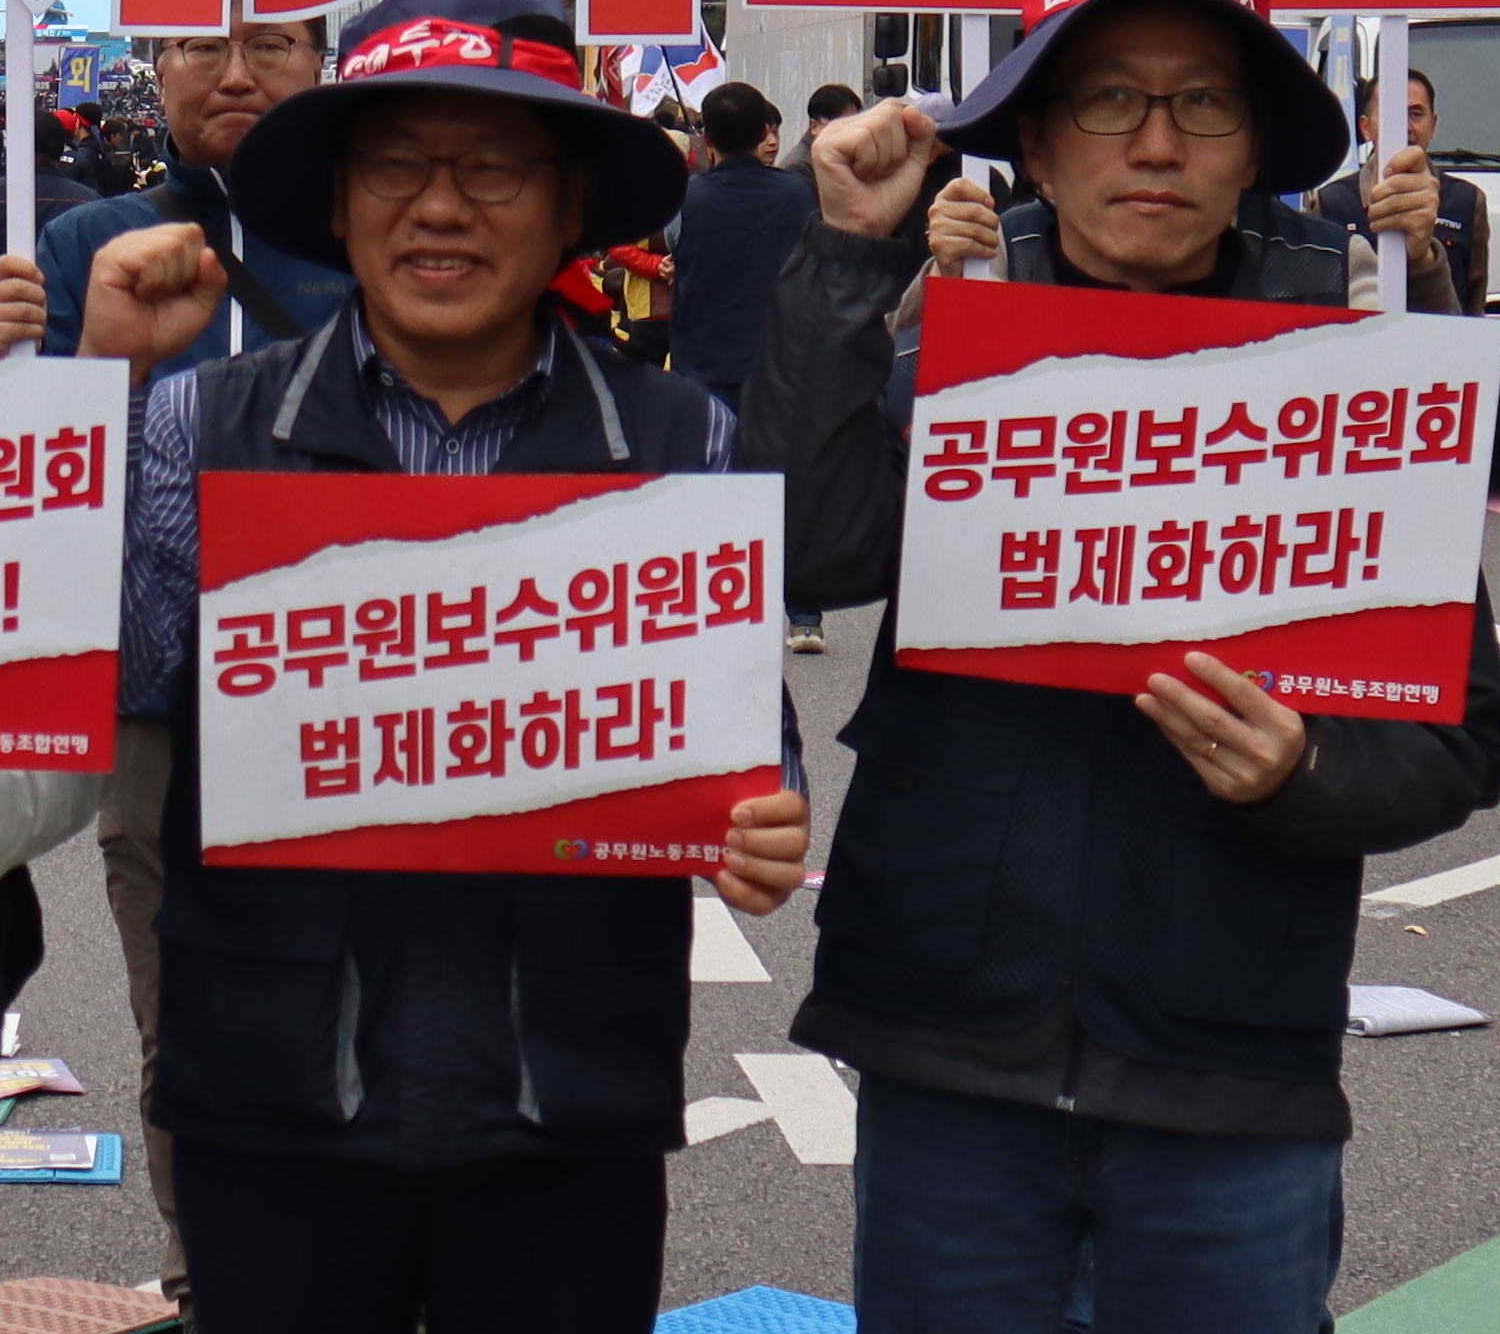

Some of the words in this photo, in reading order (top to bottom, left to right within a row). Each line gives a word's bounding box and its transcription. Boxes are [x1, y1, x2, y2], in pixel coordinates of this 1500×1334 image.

[924, 381, 1481, 502] 공무원보수위원회
[1000, 508, 1385, 611] 법제화하라!
[214, 539, 766, 697] 공무원보수위원회
[301, 678, 687, 799] 법제화하라!
[1278, 674, 1440, 705] 공무원노동조합연맹
[594, 842, 732, 863] 공무원노동조합
